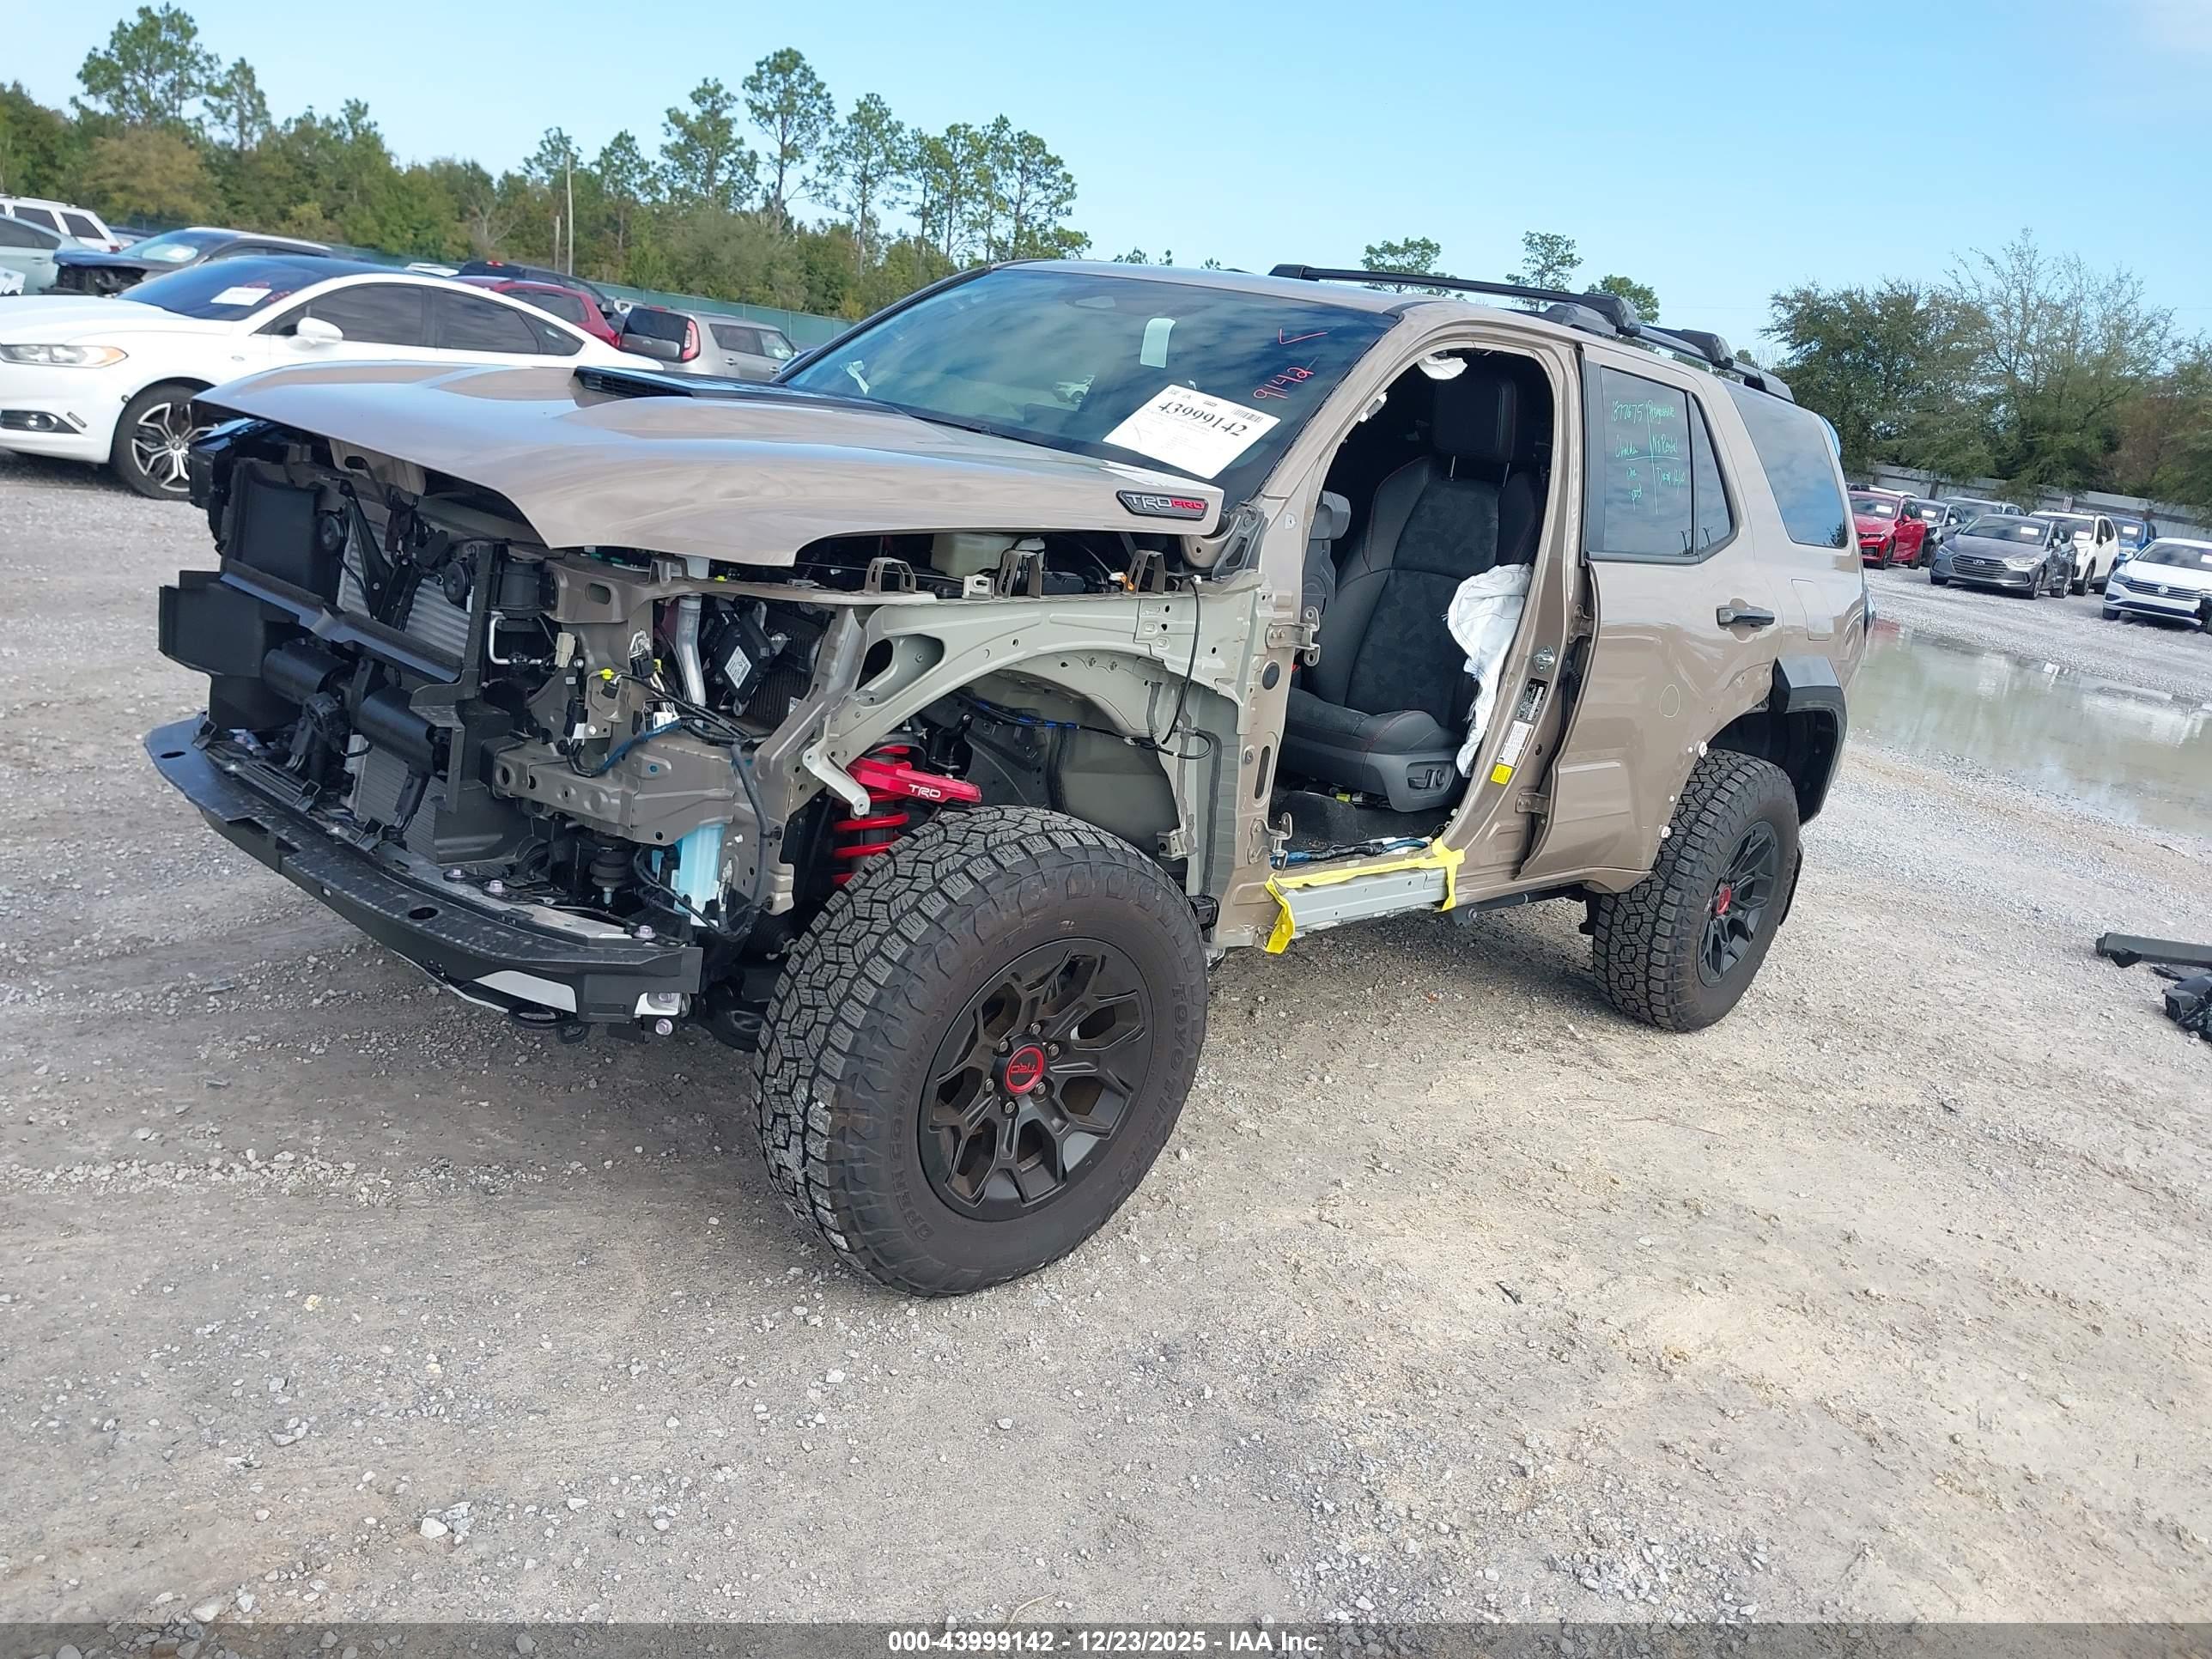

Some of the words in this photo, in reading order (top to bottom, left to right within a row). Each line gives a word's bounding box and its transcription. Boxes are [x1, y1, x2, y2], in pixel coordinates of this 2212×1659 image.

[1253, 366, 1315, 399] 9142
[1158, 400, 1248, 437] 43999142
[908, 784, 941, 799] TRD
[1170, 981, 1188, 1073] TOYO
[1010, 1062, 1037, 1073] TRD
[891, 1169, 935, 1242] OPEN
